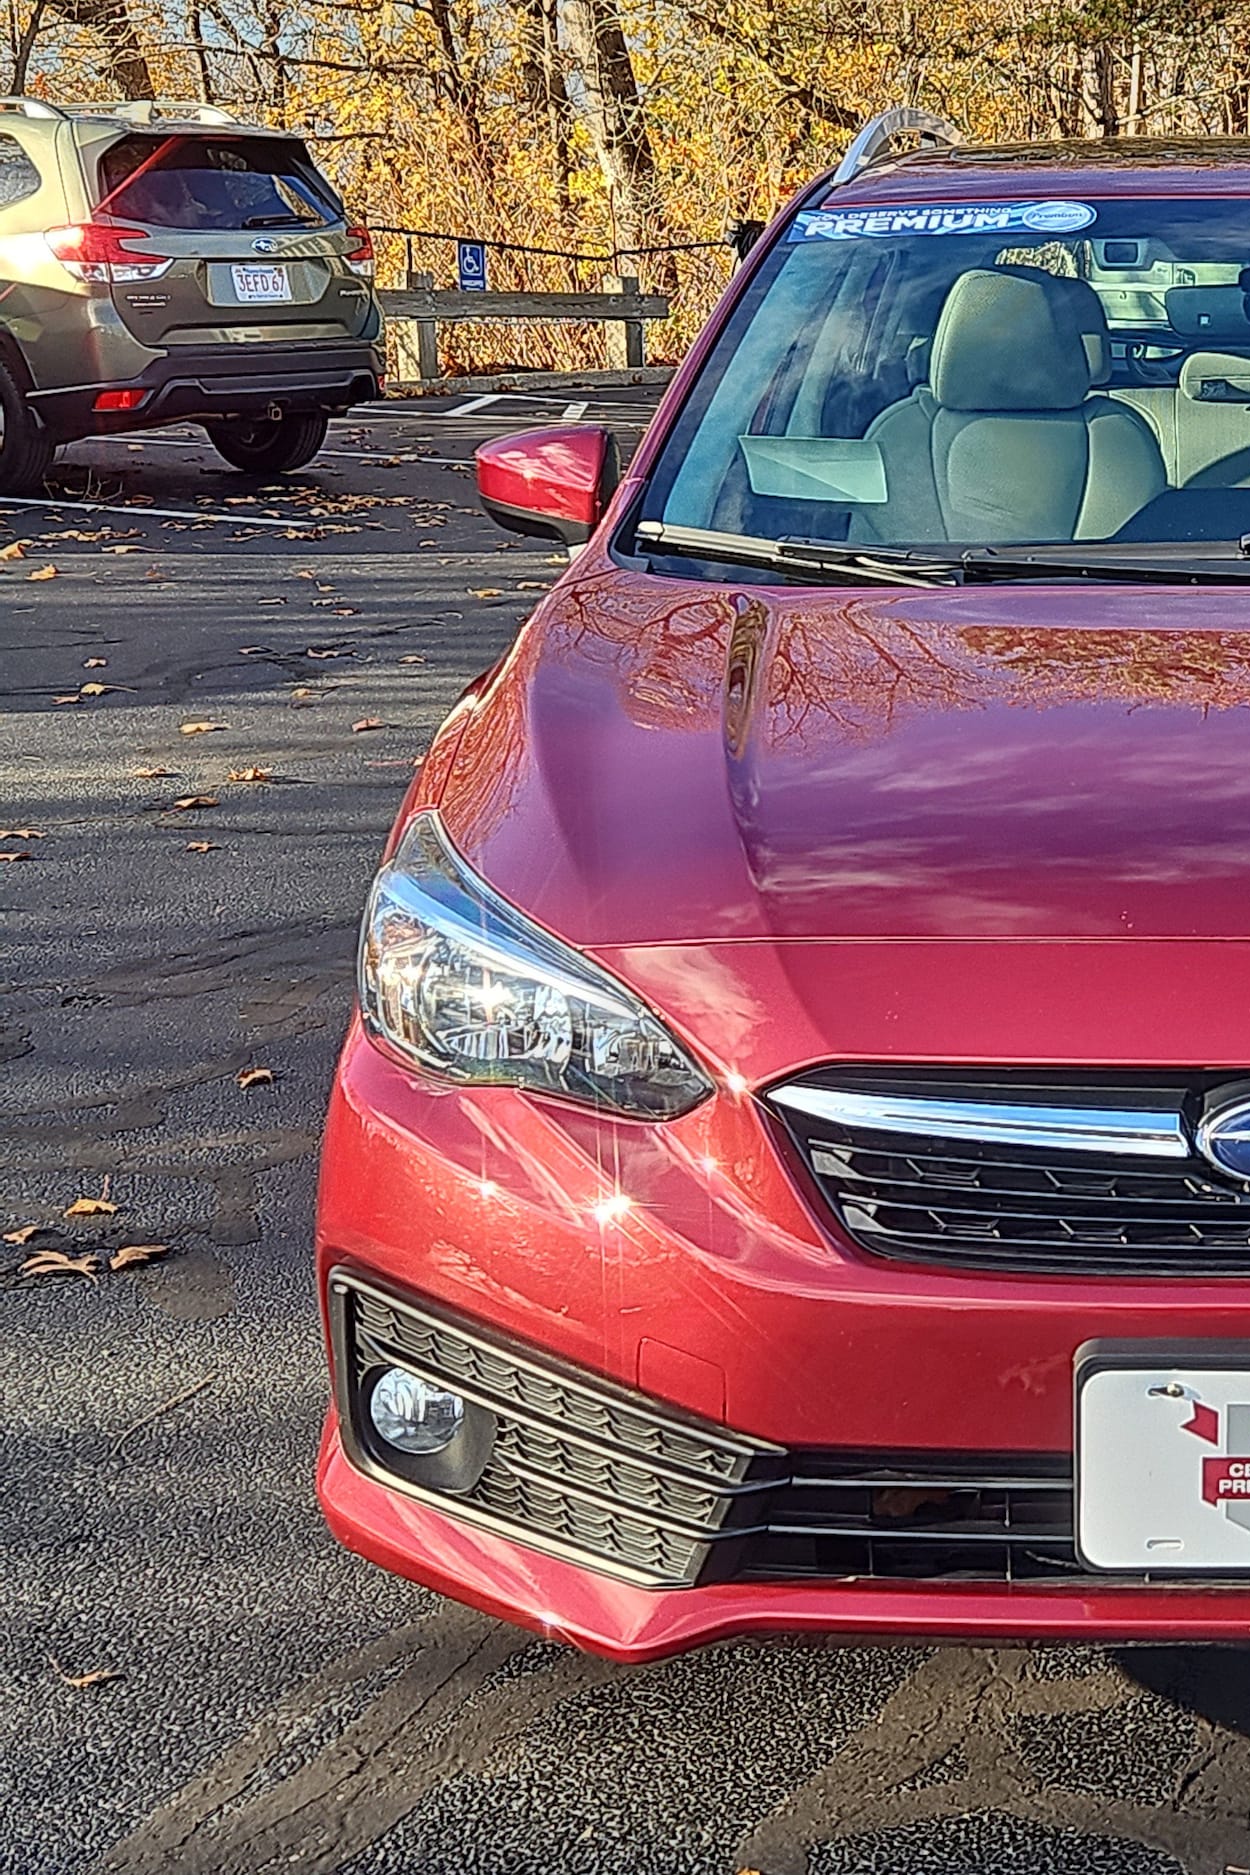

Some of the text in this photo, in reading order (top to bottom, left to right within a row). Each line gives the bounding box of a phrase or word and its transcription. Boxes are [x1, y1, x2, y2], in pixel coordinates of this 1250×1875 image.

[848, 209, 918, 219] DESERVE
[922, 207, 1012, 216] SOMETHING
[804, 214, 1010, 236] PREMIUM
[236, 274, 285, 292] 3EFD 67
